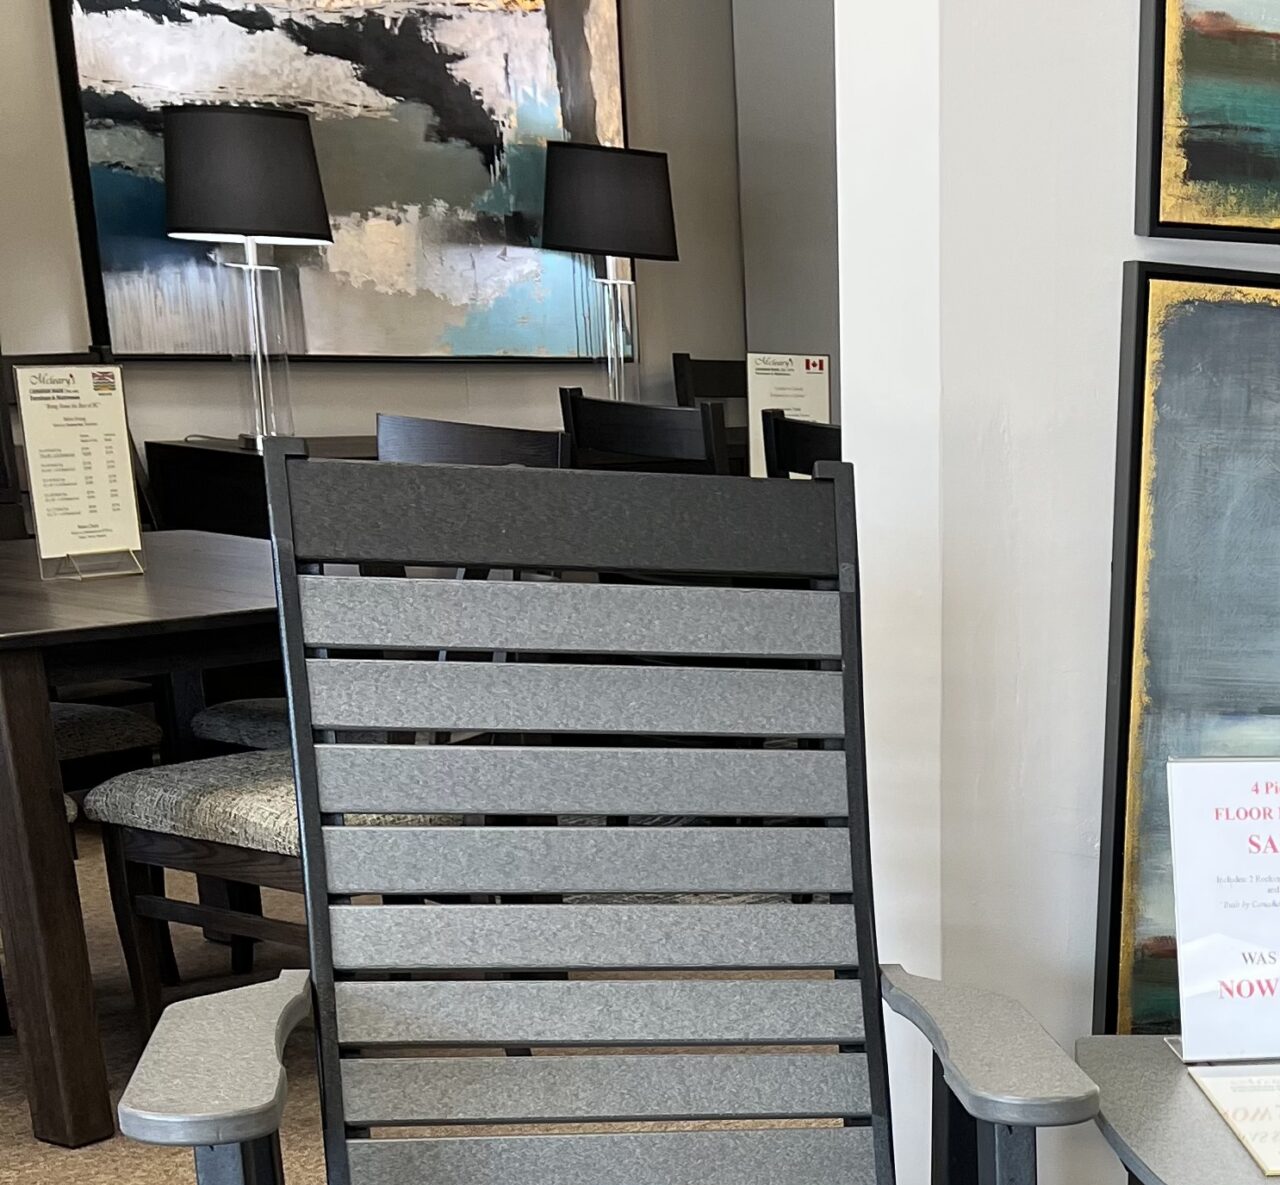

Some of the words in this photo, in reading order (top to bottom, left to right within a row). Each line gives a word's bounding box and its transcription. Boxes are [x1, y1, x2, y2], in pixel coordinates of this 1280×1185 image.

[1251, 782, 1260, 795] 4
[1214, 806, 1274, 821] FLOOR
[1241, 951, 1277, 965] WAS
[1217, 978, 1280, 999] NOW
